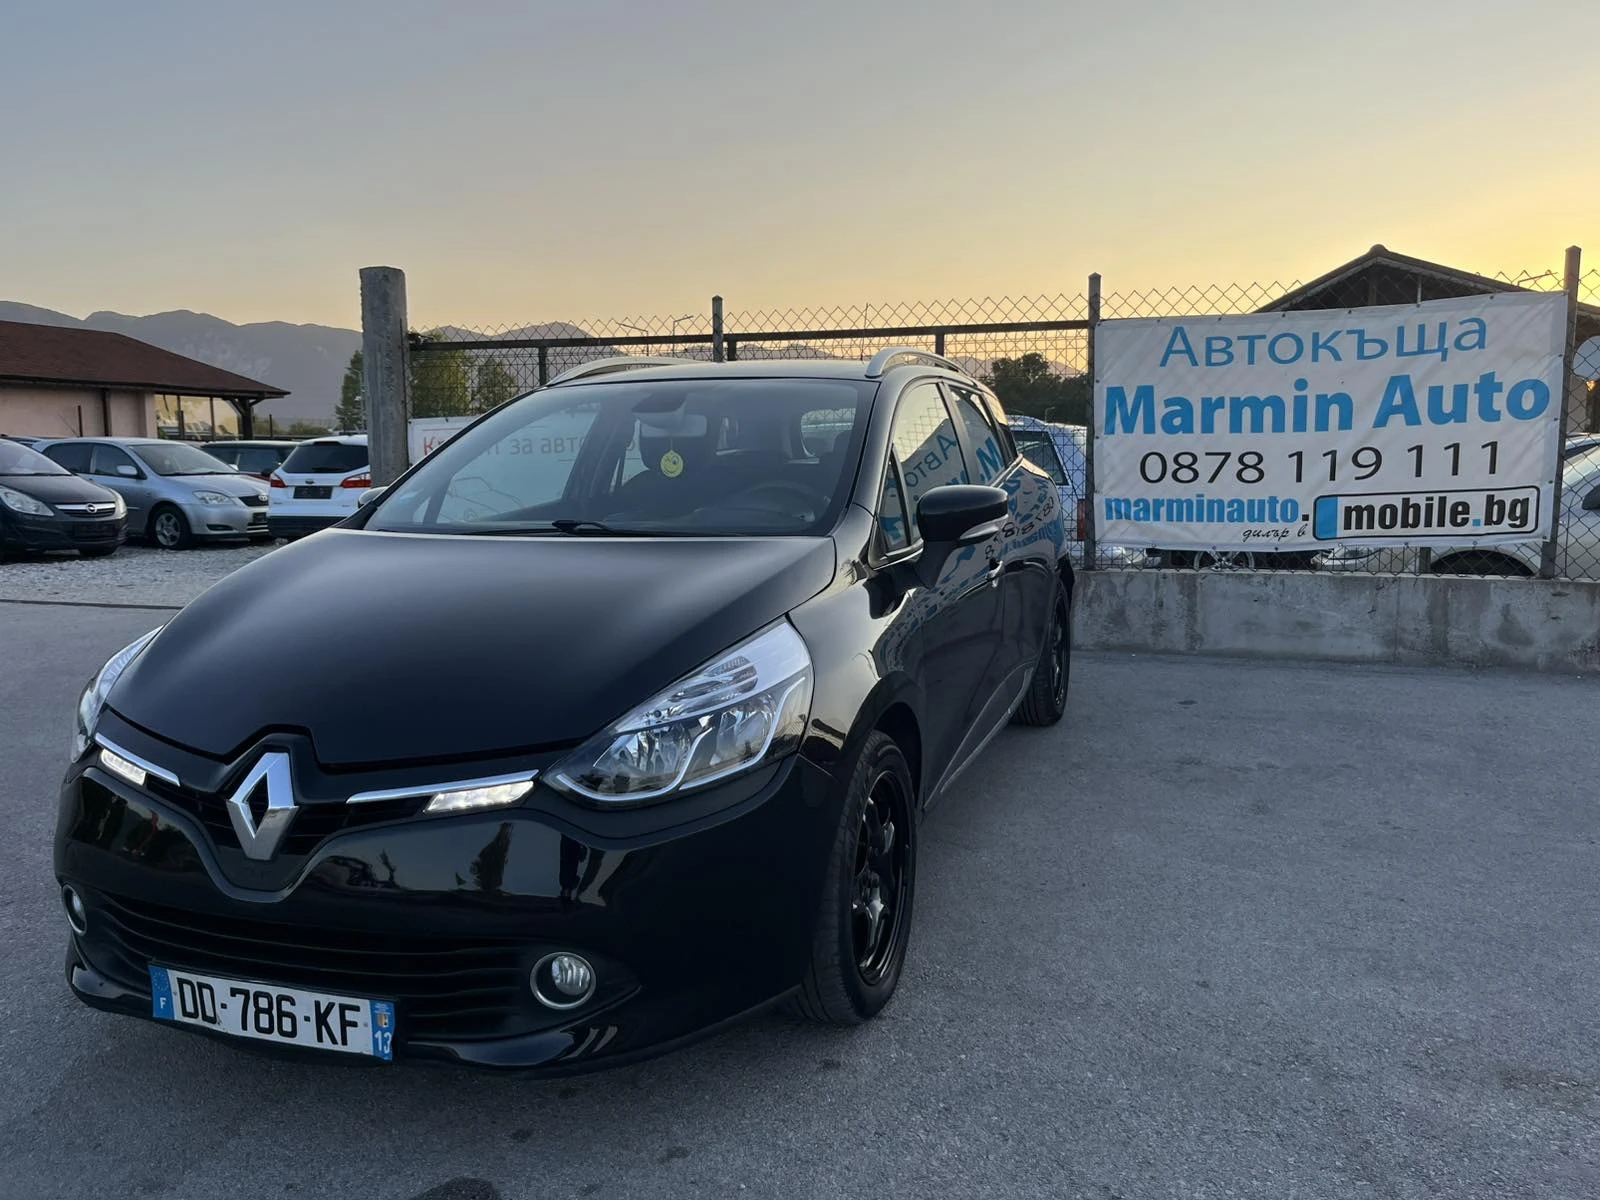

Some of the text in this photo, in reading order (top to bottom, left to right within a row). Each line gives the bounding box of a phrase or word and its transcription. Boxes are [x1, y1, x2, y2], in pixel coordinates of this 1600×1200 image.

[1159, 316, 1486, 368] Автокъща
[1103, 371, 1550, 436] Marmin Auto
[1140, 441, 1498, 484] 0878 119 111
[1343, 493, 1530, 530] mobile.bg
[160, 997, 167, 1009] F
[176, 977, 361, 1046] DD-786-KF
[374, 1030, 392, 1054] 13
